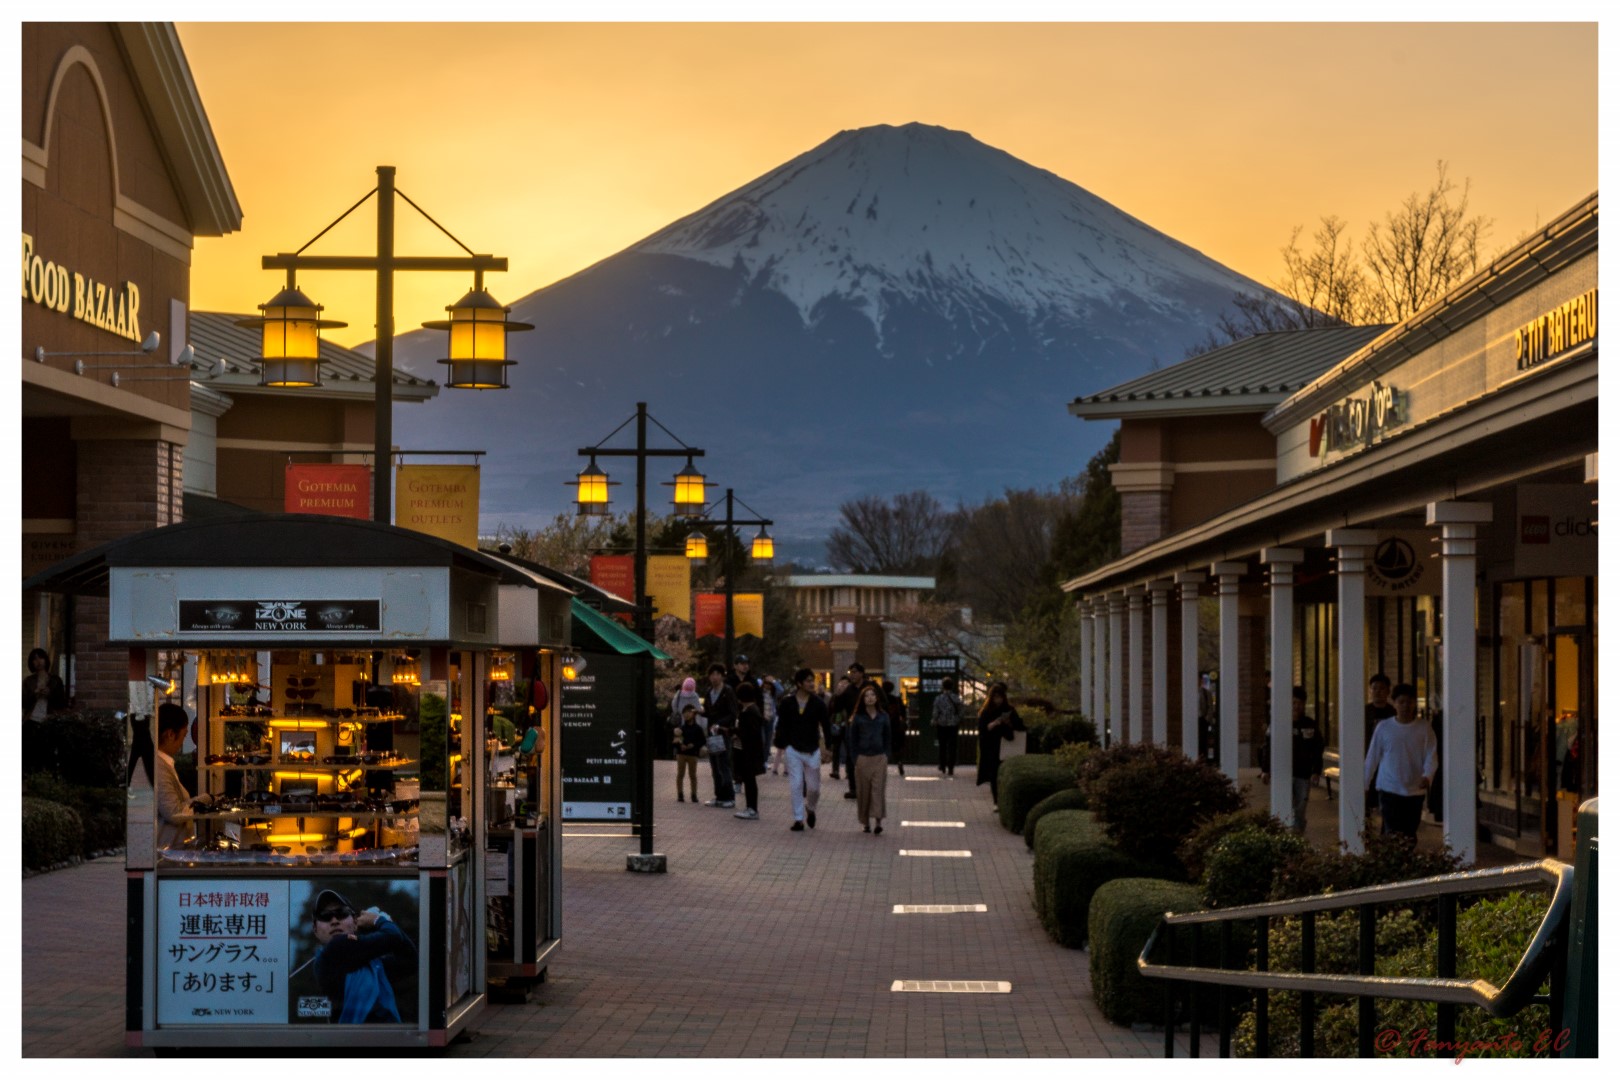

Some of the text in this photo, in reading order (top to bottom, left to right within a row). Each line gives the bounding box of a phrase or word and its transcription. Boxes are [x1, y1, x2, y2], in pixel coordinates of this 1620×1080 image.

[22, 231, 142, 343] FOOD BAZAAR
[1515, 288, 1597, 369] PETIT BATEAU
[300, 498, 354, 508] PREMIUM
[410, 499, 464, 509] PREMIUM
[411, 514, 462, 524] OUTLETS
[1554, 517, 1598, 537] click
[32, 541, 75, 549] GIVENC
[255, 622, 307, 630] NEW YORK
[574, 776, 599, 784] BAZAAR
[179, 892, 270, 907] 日本特許取得
[180, 914, 266, 935] 運転専用
[172, 971, 274, 993] 「あります。」
